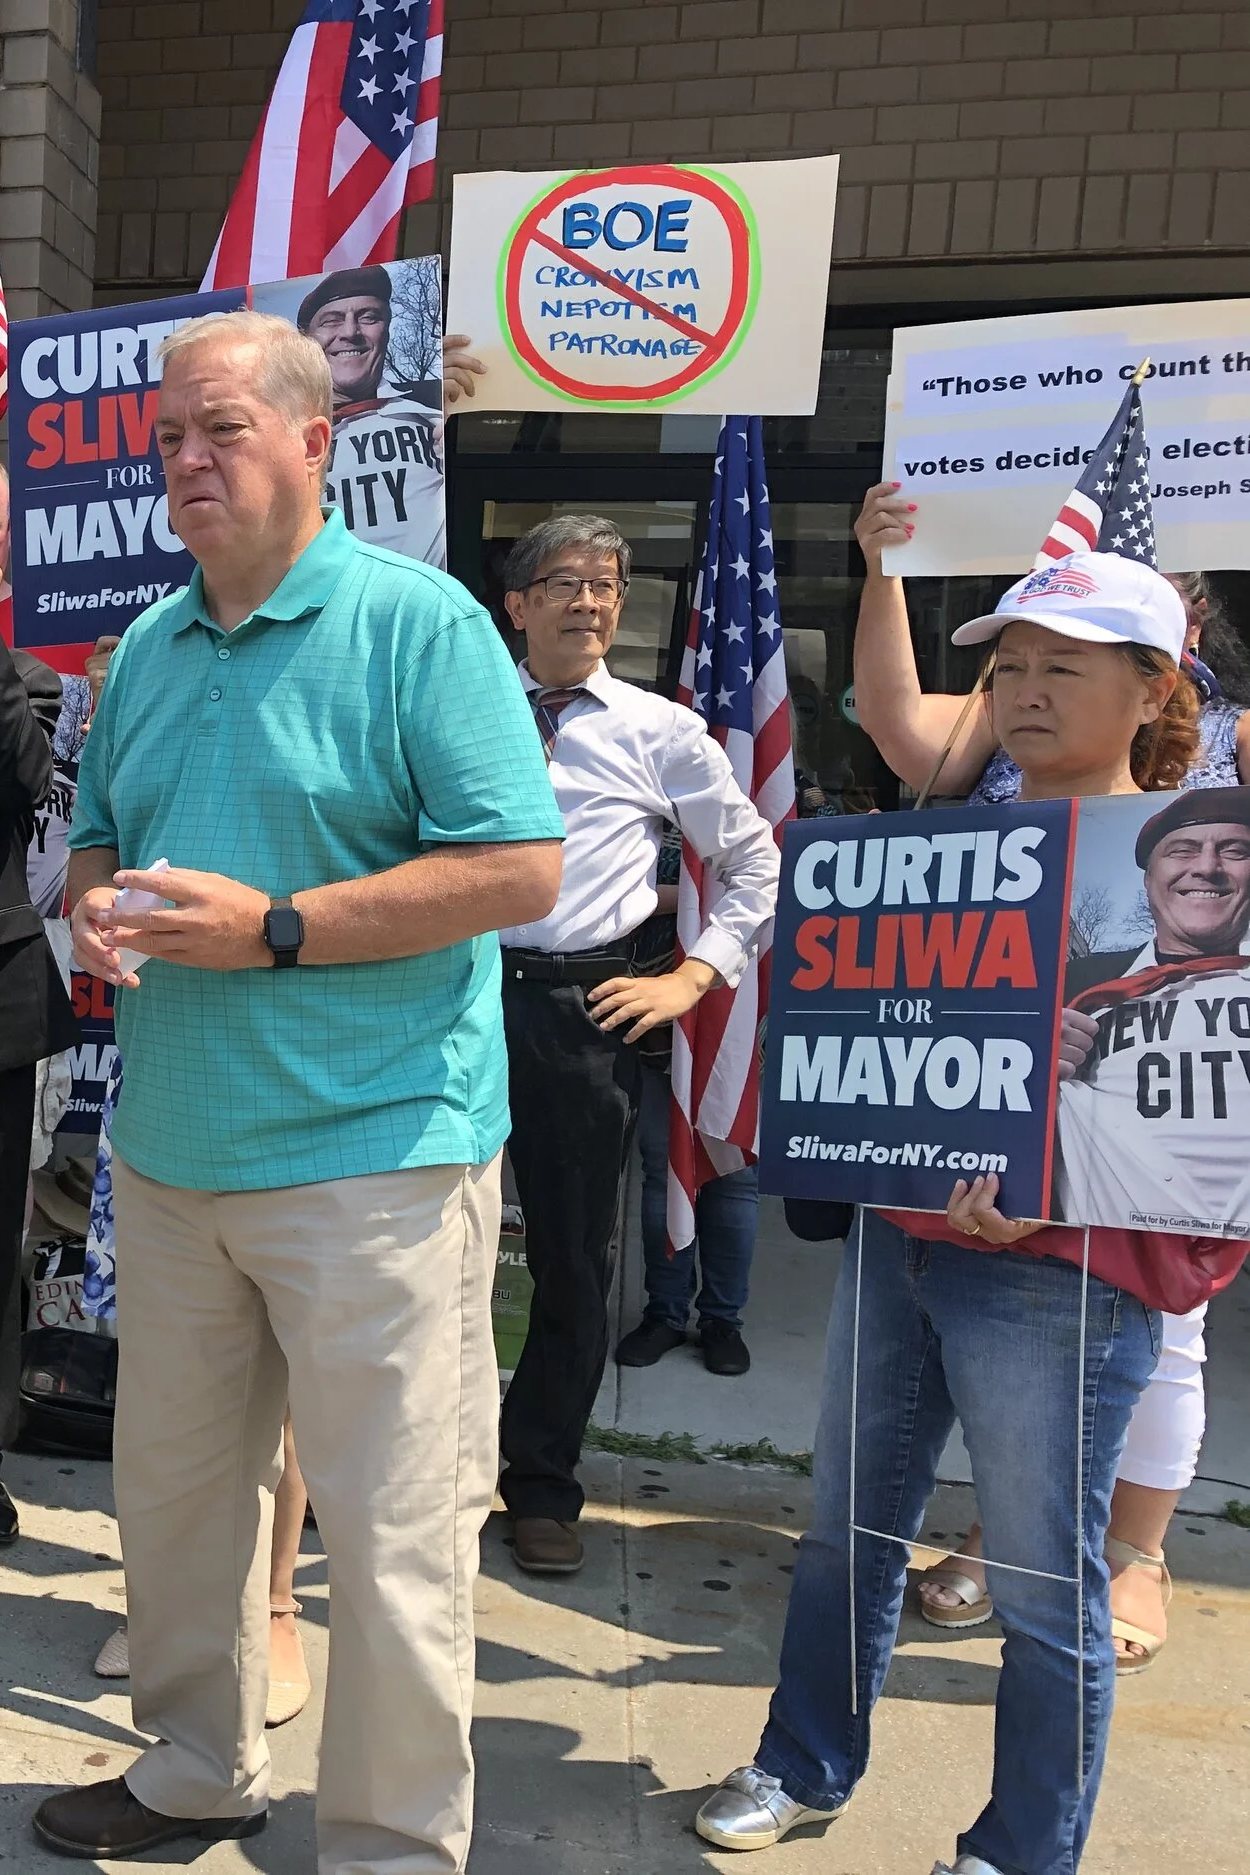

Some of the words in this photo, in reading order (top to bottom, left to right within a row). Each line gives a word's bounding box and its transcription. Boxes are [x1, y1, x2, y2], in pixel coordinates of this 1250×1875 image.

[562, 199, 692, 253] BOE
[540, 300, 698, 323] NEPOTISM
[20, 311, 227, 399] CURT
[548, 331, 703, 359] PATRONAGE
[1038, 365, 1103, 389] who
[1118, 355, 1211, 380] count
[105, 464, 154, 490] FOR
[904, 455, 985, 477] votes
[1151, 480, 1231, 499] Joseph
[26, 494, 186, 566] MAYO
[1062, 584, 1091, 597] TRUST
[793, 826, 1048, 910] CURTIS
[790, 909, 1038, 991] SLIWA
[877, 998, 933, 1024] FOR
[780, 1035, 1033, 1112] MAYOR
[786, 1136, 1008, 1173] SliwaForNY.com
[1148, 1216, 1158, 1224] for
[1159, 1216, 1168, 1227] by
[1169, 1217, 1190, 1227] Curtis
[1211, 1222, 1222, 1230] for
